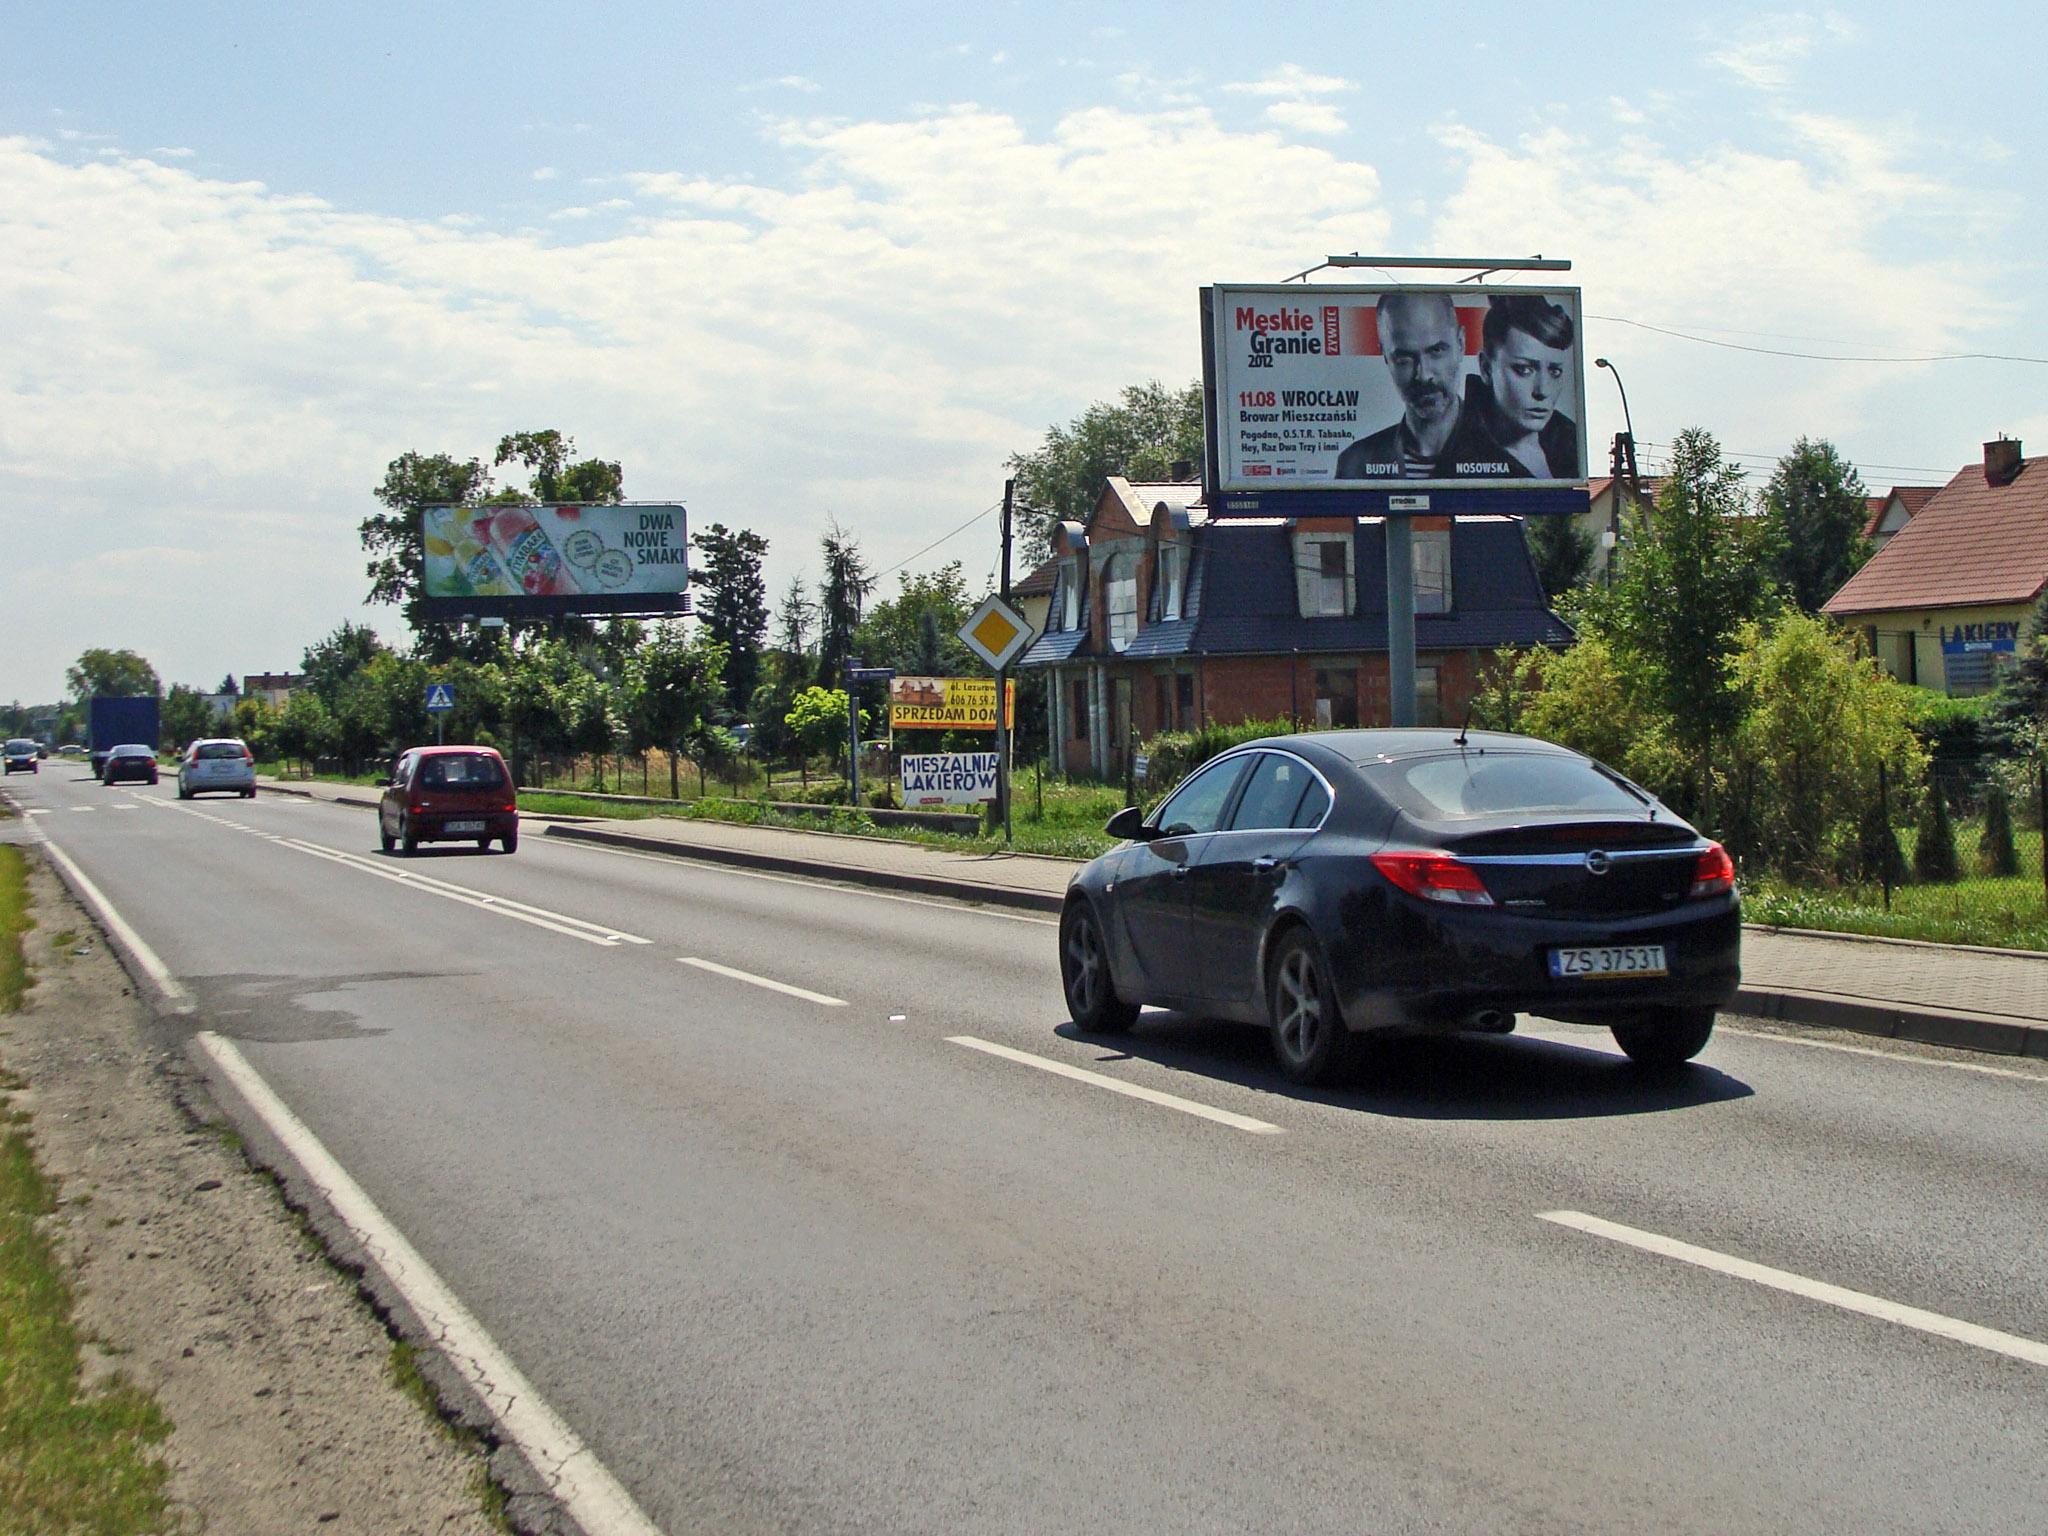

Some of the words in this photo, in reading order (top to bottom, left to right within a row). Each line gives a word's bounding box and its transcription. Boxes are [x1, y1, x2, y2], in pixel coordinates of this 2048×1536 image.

[1236, 307, 1314, 337] Męskie
[1250, 330, 1321, 354] Granie
[1247, 354, 1274, 368] 2012
[1239, 391, 1276, 407] 11.08
[1282, 389, 1360, 407] WROCŁAW
[1240, 410, 1279, 423] Browar
[1282, 409, 1357, 422] Mieszczański
[1240, 430, 1281, 442] Pogodno,
[1318, 429, 1355, 440] Tabasko,
[1241, 443, 1260, 454] Hey,
[1262, 443, 1276, 452] Raz
[1279, 443, 1297, 452] Dwa
[1299, 442, 1316, 453] Trzy
[1323, 442, 1339, 451] inni
[1365, 460, 1399, 474] BUDYŃ
[1456, 462, 1510, 474] NOSOWSKA
[639, 514, 674, 530] DWA
[623, 531, 668, 548] NOWE
[637, 548, 684, 565] SMAKI
[895, 706, 965, 721] SPRZEDAM
[903, 754, 999, 773] MIESZALNIA
[1562, 950, 1593, 973] ZS
[1601, 947, 1661, 971] 3753T
